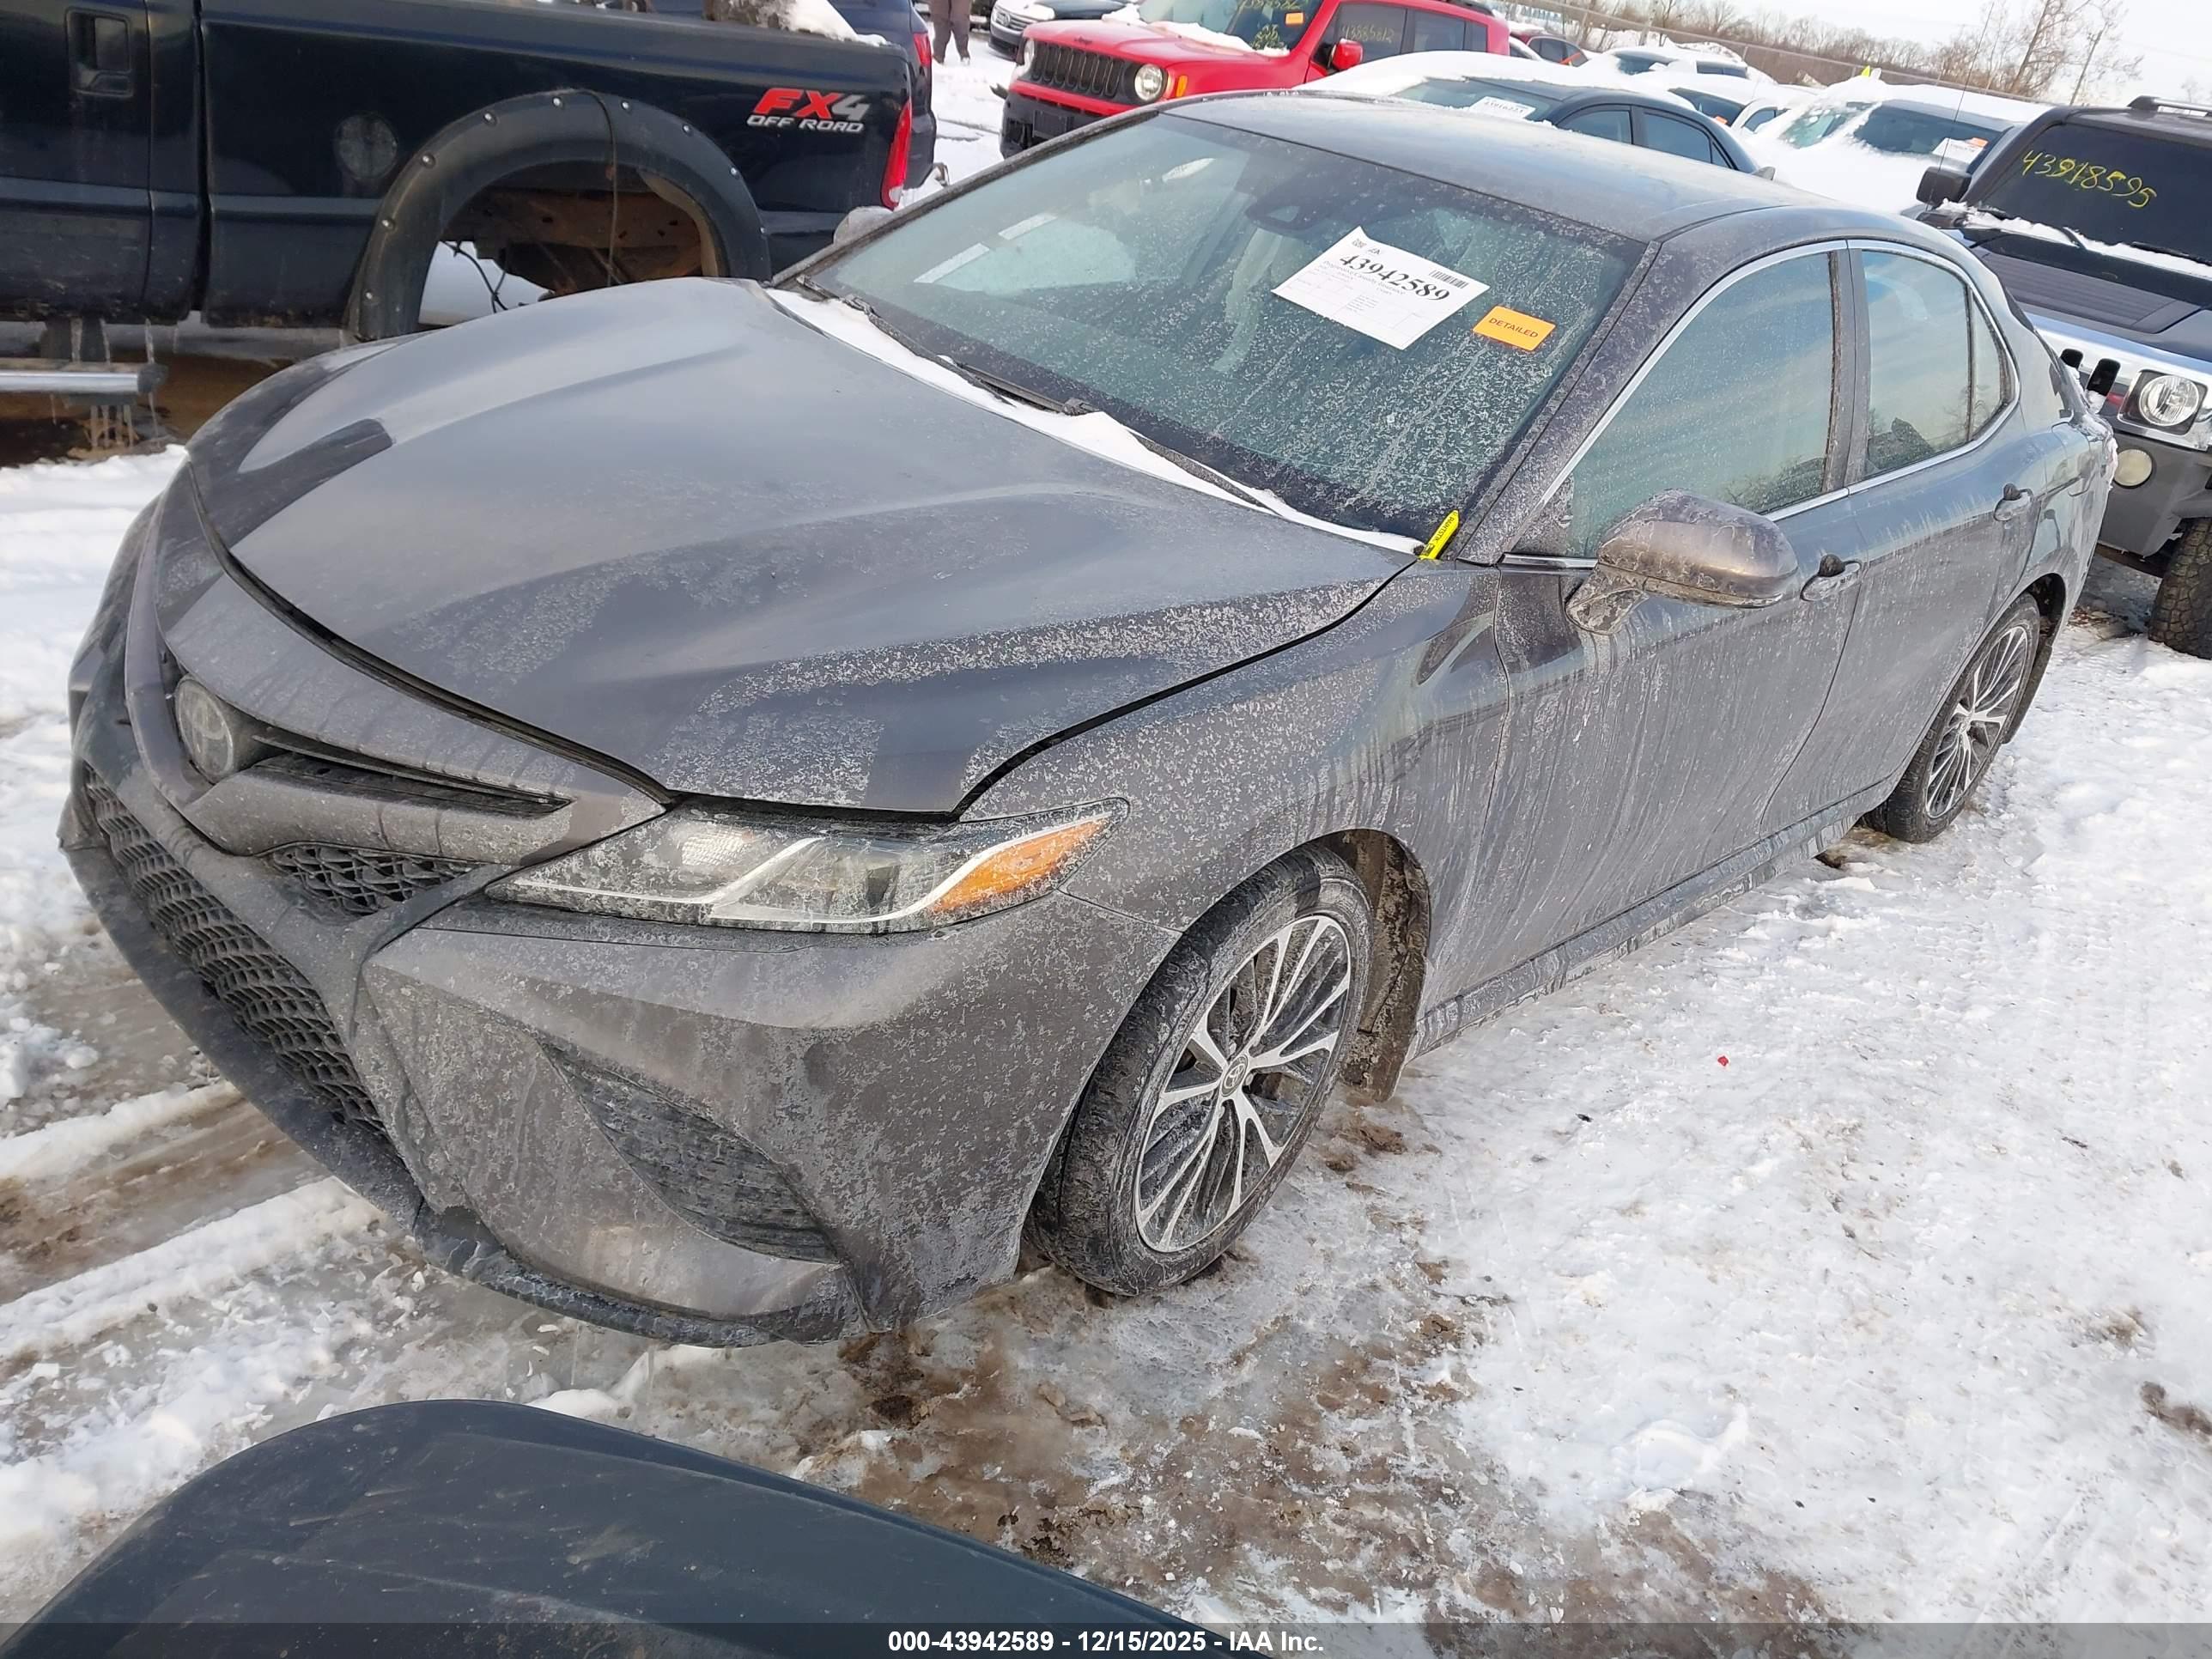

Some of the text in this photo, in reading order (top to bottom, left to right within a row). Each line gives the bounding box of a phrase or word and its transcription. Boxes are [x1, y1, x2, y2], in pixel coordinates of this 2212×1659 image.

[753, 88, 870, 121] FX4
[746, 115, 864, 132] OFF ROAD
[2022, 150, 2157, 208] 43918595
[1340, 255, 1450, 301] 43942589
[1489, 317, 1538, 338] DETAILED
